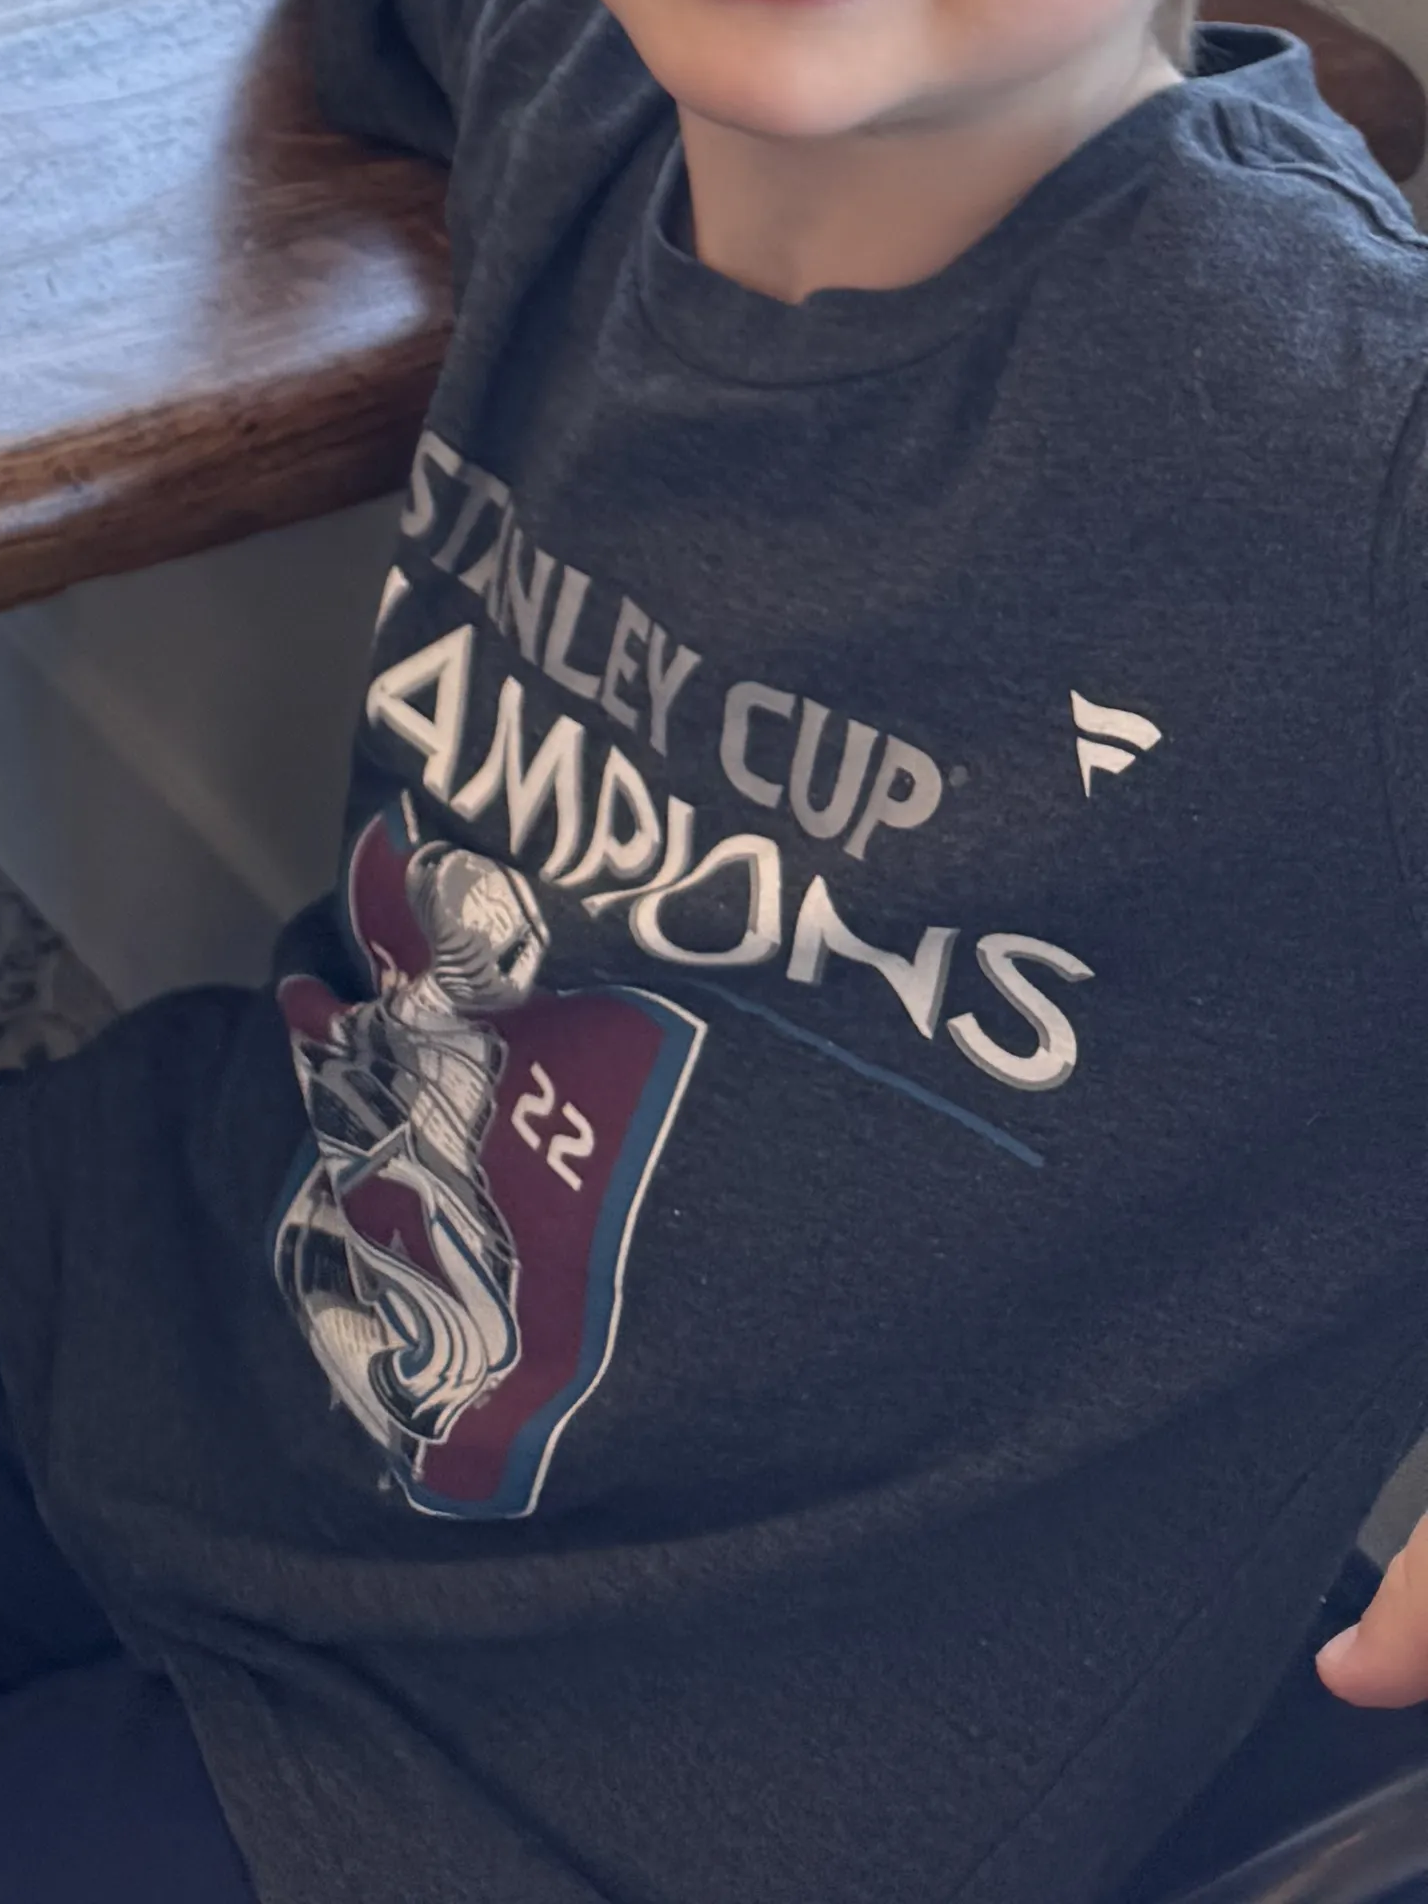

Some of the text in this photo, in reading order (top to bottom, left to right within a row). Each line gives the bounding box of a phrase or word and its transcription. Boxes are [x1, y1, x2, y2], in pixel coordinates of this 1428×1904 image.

[399, 430, 944, 862] STANLEY CUP
[510, 1059, 595, 1192] 22
